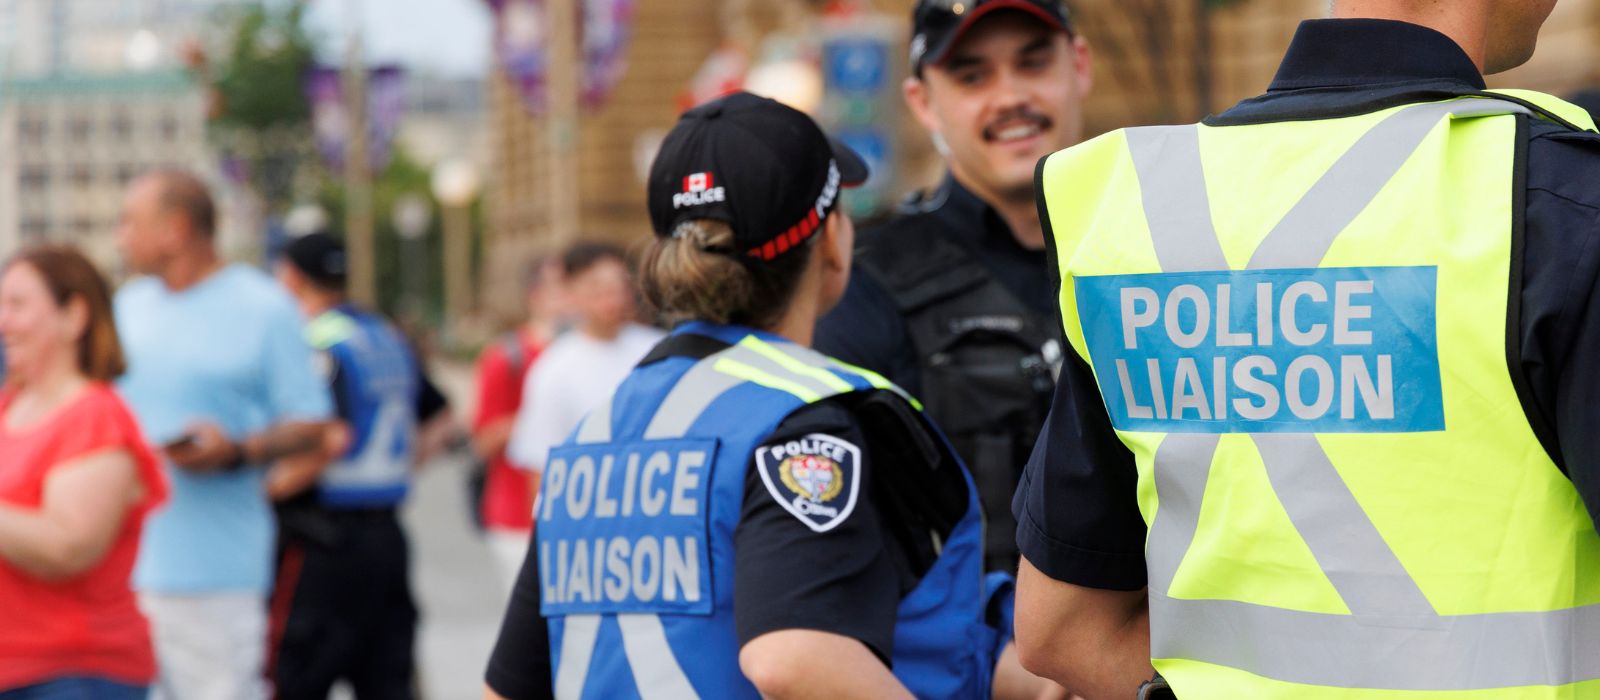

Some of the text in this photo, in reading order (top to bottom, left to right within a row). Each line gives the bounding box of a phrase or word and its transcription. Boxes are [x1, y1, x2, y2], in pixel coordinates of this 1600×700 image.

[673, 187, 725, 209] POLICE
[1120, 280, 1374, 349] POLICE
[1115, 354, 1395, 420] LIAISON
[771, 439, 847, 463] POLICE
[542, 451, 706, 521] POLICE
[541, 535, 701, 604] LIAISON
